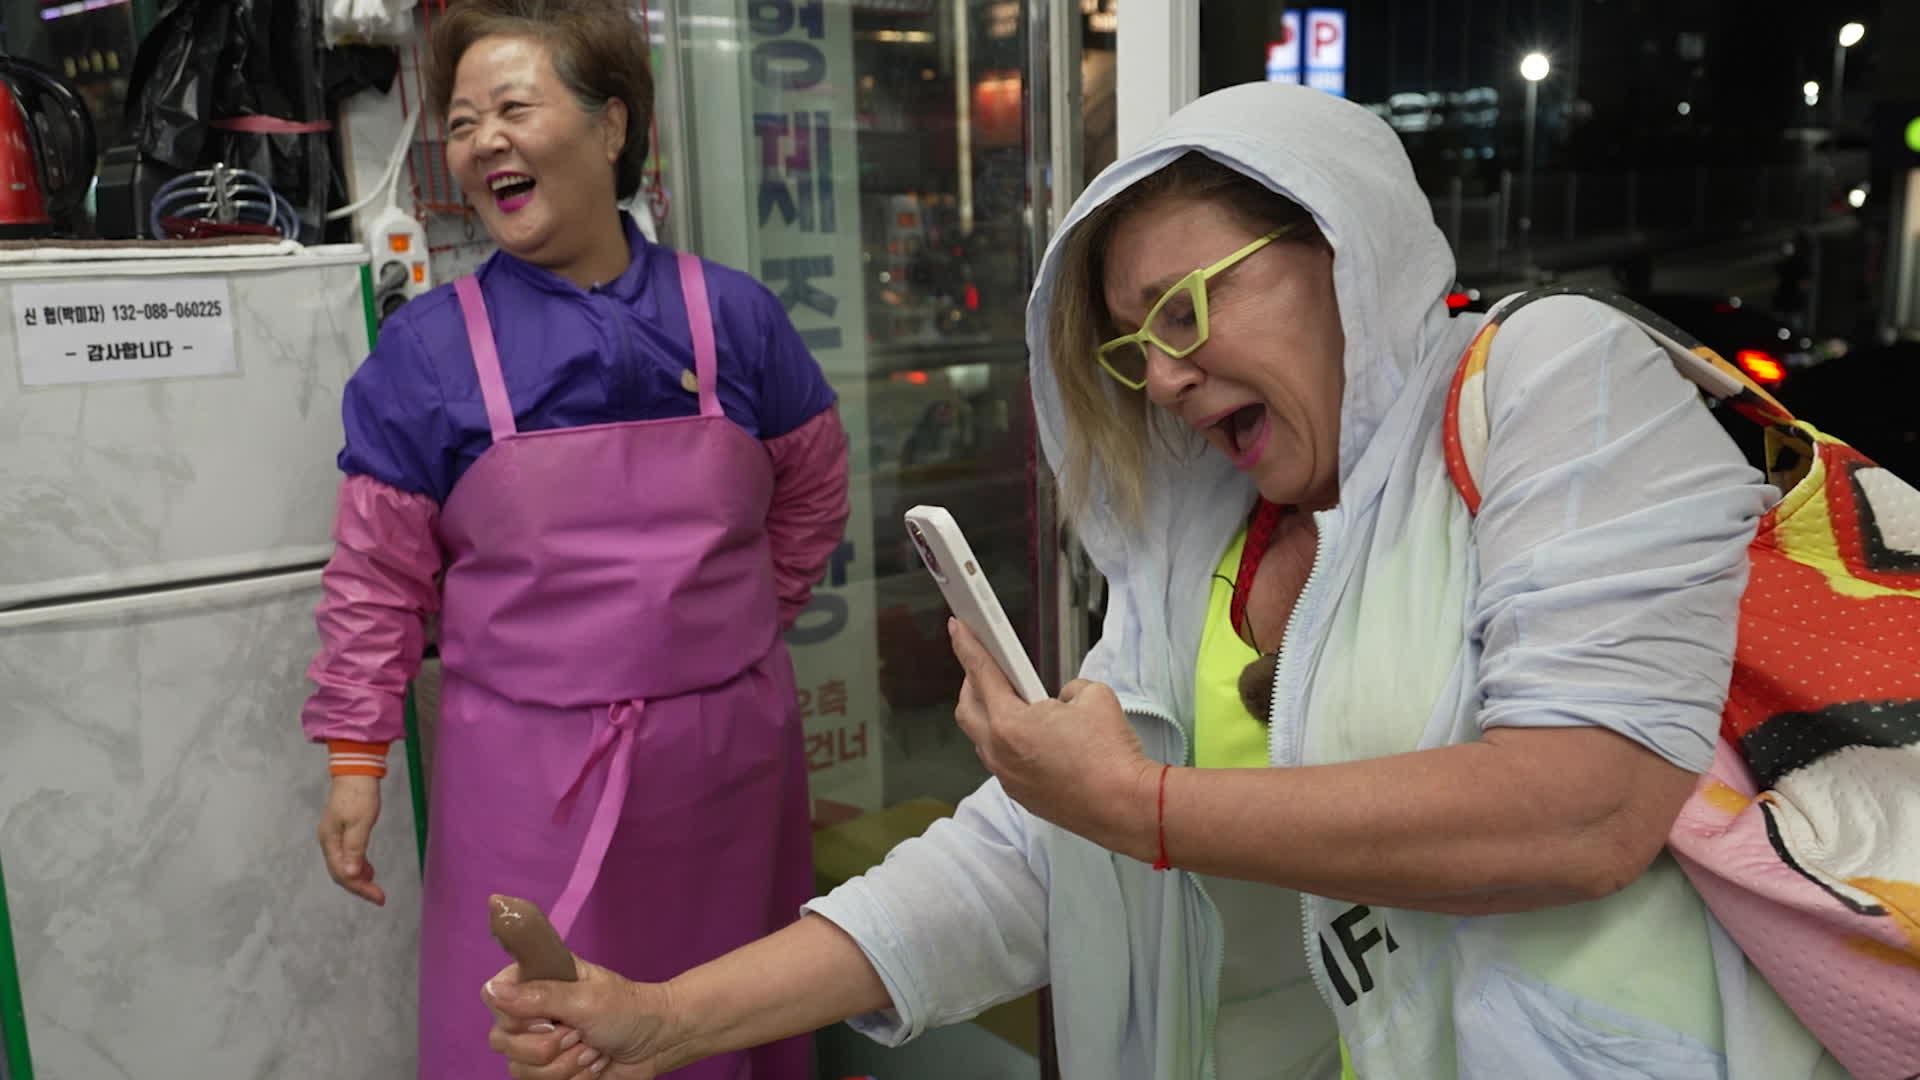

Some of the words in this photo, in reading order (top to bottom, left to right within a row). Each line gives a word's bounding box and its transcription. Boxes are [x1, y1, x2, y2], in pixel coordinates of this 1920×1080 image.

[1313, 20, 1340, 59] P
[24, 307, 37, 326] 신
[112, 301, 222, 321] 132-088-060225
[87, 341, 173, 362] 감사합니다
